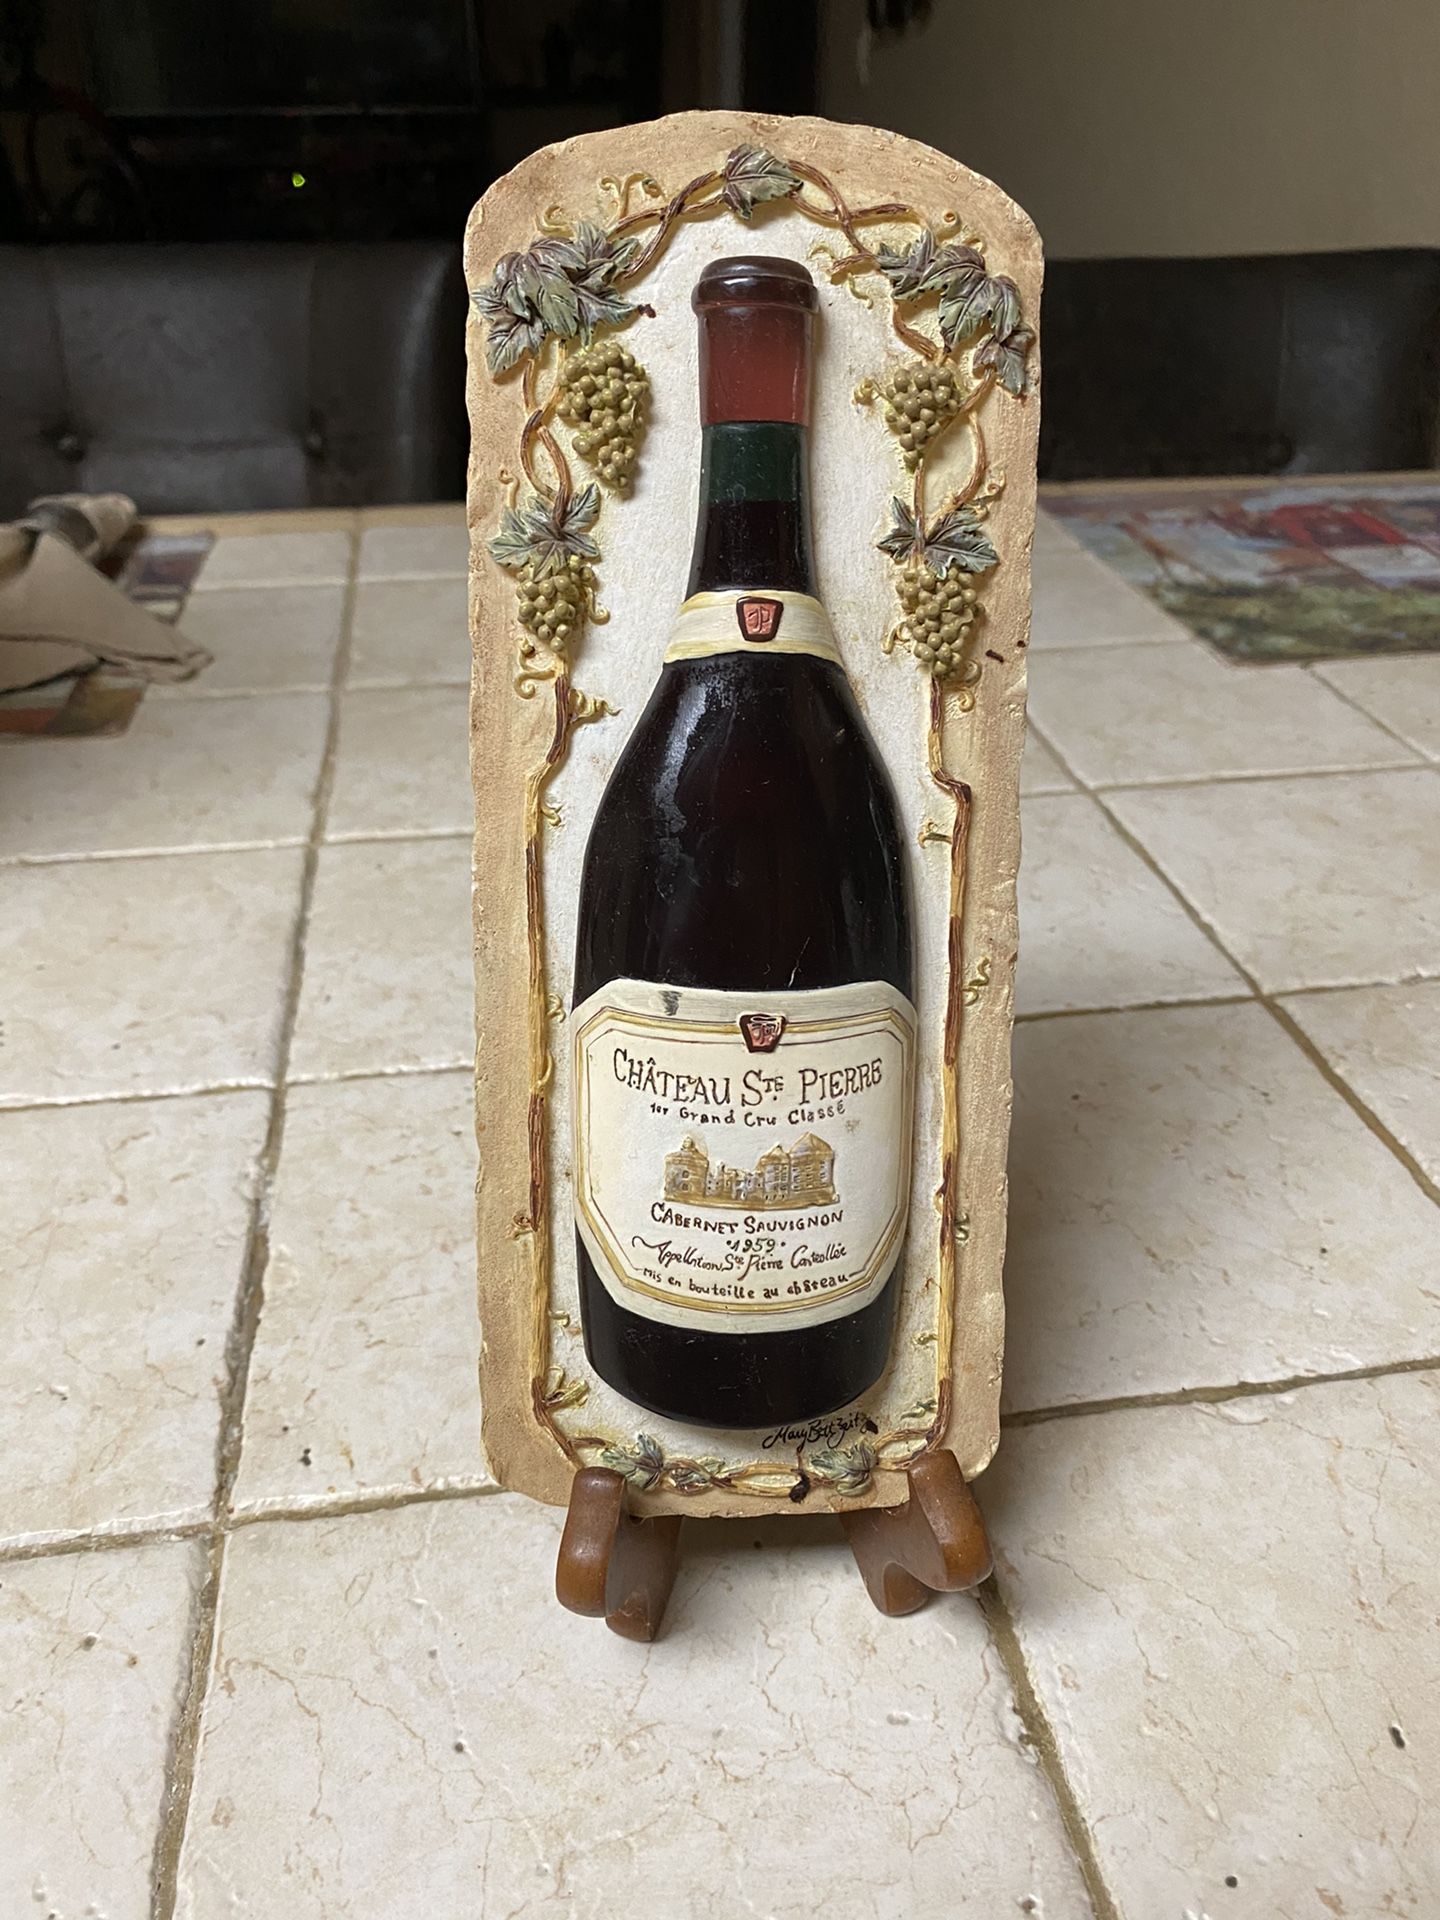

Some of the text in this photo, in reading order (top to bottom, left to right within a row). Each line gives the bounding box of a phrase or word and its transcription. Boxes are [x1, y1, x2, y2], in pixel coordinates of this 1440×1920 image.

[613, 1047, 731, 1106] CHÂTEAU
[798, 1057, 883, 1106] PIERRE
[650, 1099, 846, 1128] 1er Grand Cru Classé
[650, 1201, 844, 1235] CABERNET SAUVIGNON
[737, 1254, 784, 1282] Pierre
[667, 1276, 682, 1288] en
[689, 1278, 755, 1300] bouteille
[763, 1287, 779, 1300] au
[762, 1425, 808, 1453] Mary
